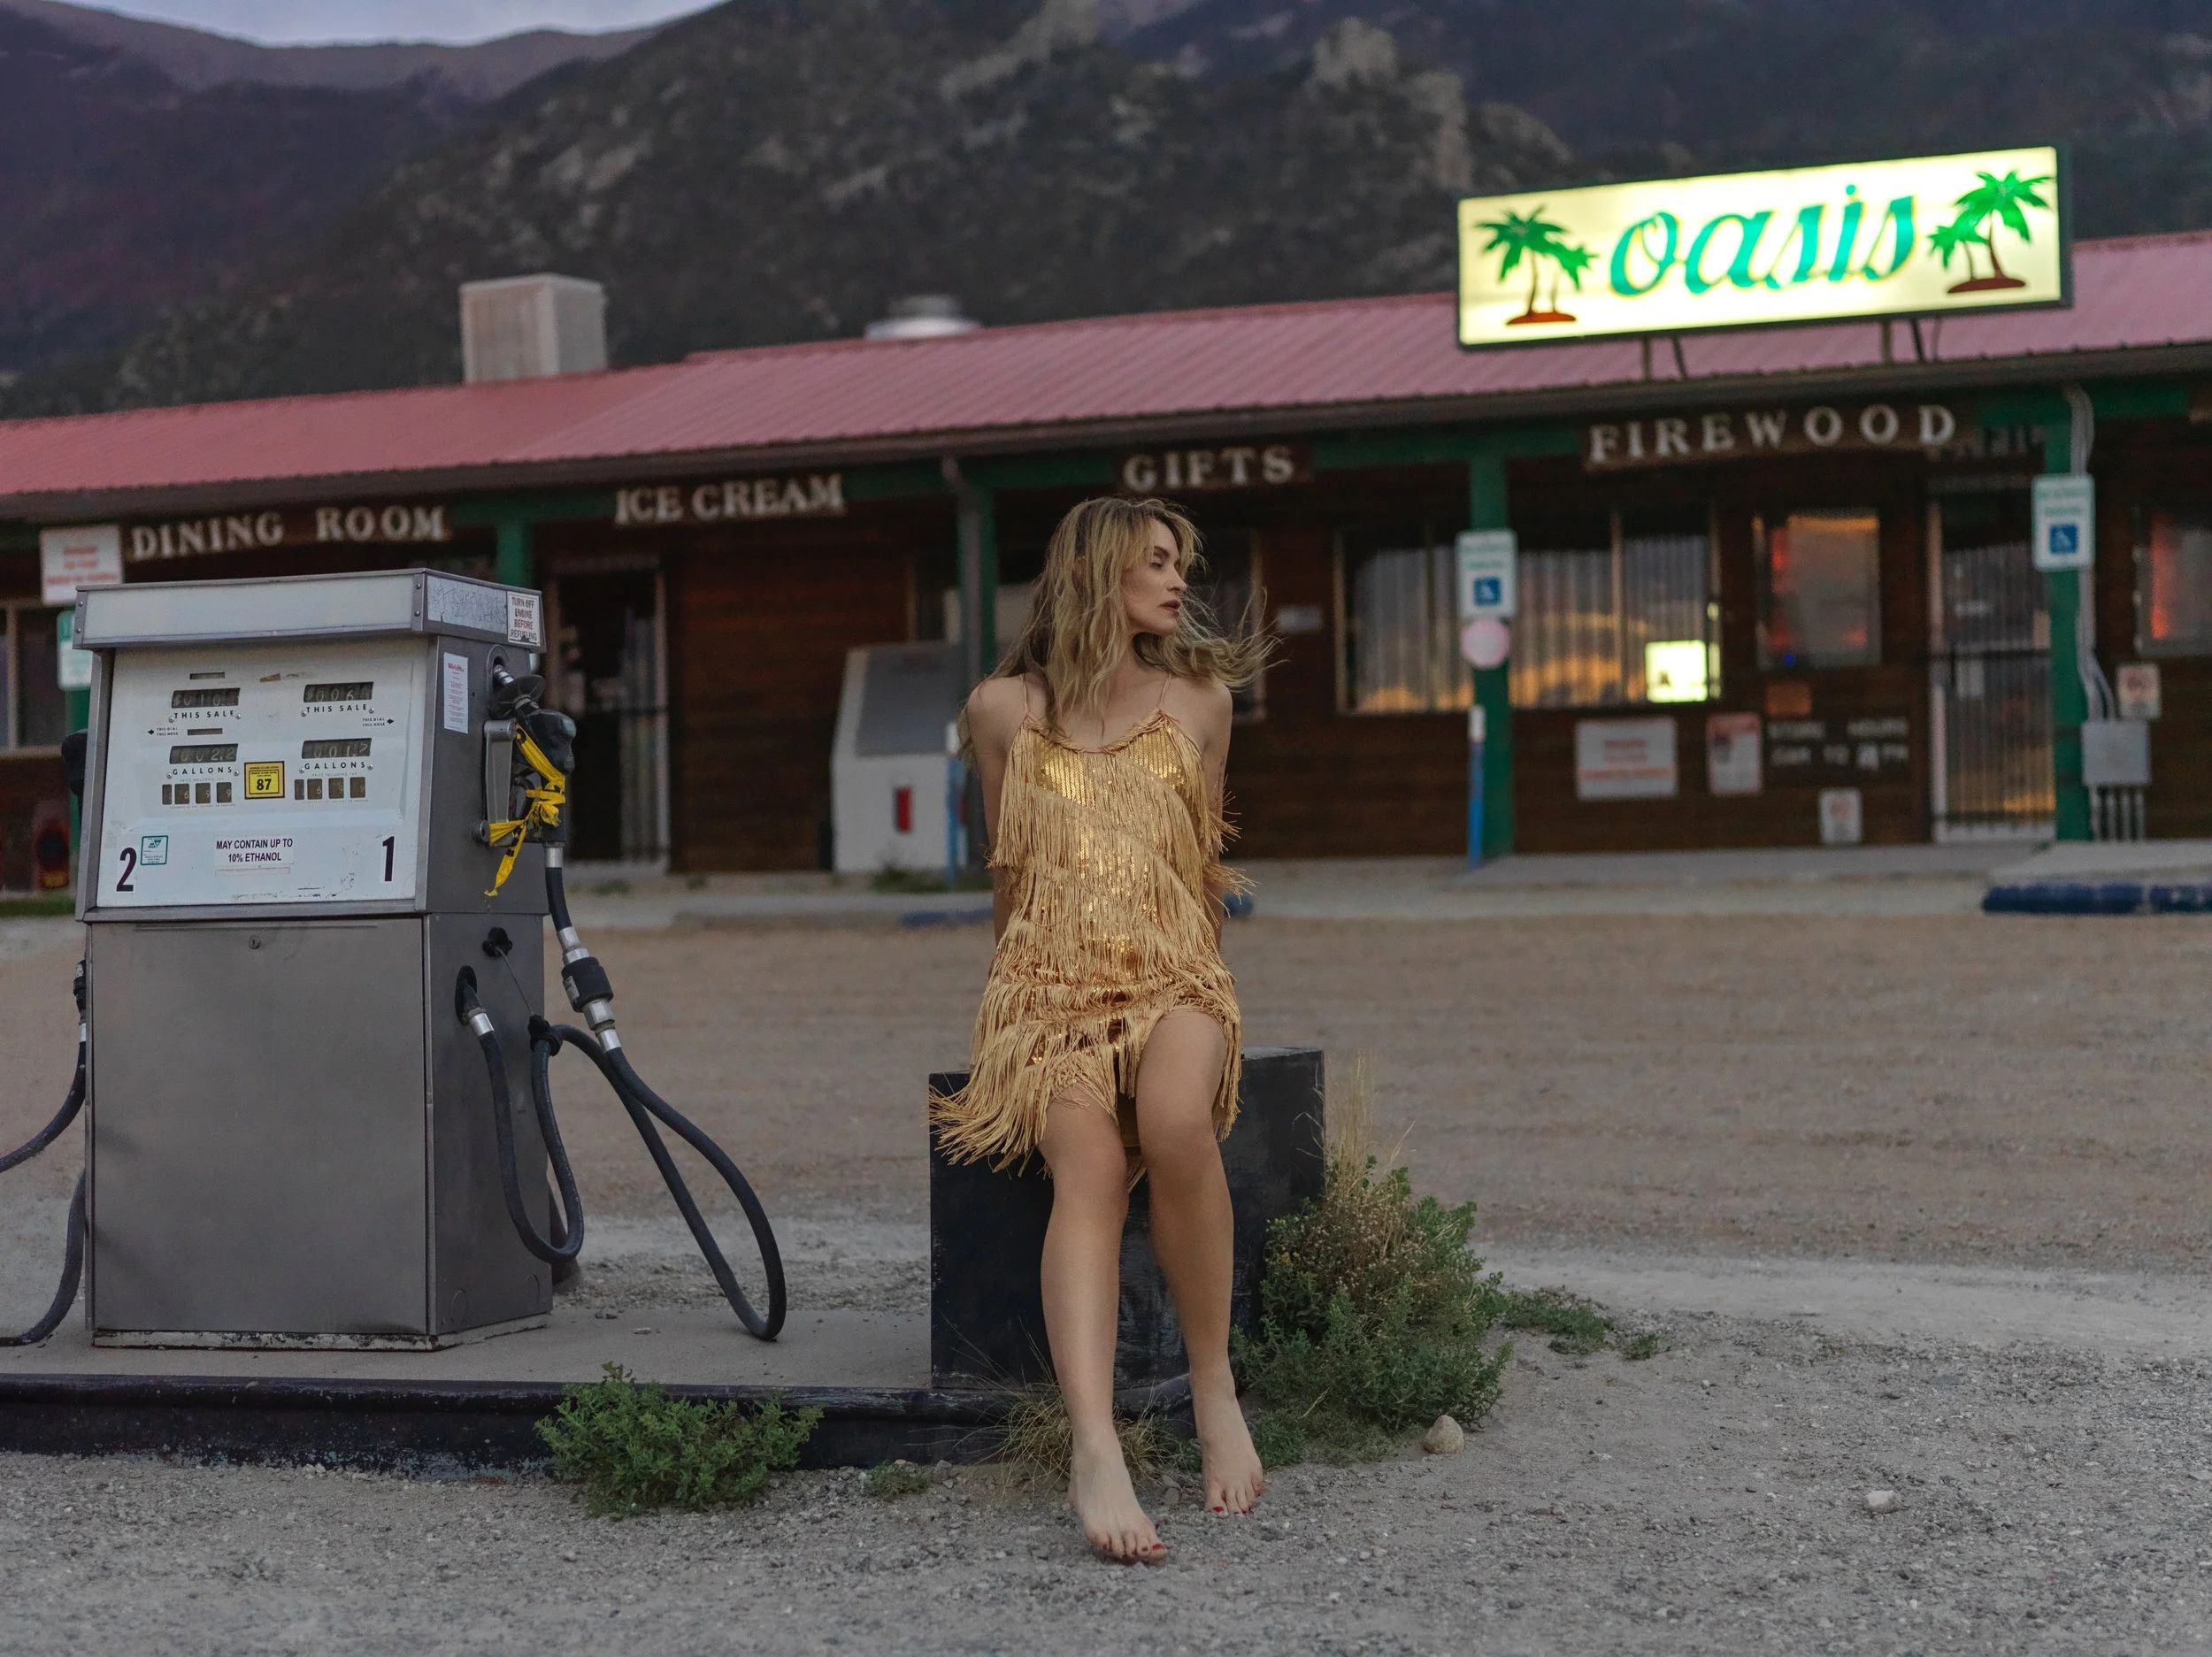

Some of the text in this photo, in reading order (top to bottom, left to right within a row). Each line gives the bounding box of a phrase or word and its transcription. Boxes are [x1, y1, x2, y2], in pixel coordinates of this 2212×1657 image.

[1610, 184, 1916, 296] oasis
[1590, 403, 1955, 464] FIREWOOD
[1123, 444, 1295, 491] GIFTS
[615, 473, 845, 525] ICE CREAM
[130, 505, 449, 561] DINING ROOM
[511, 596, 535, 609] TURN OFF
[514, 608, 533, 619] ENGINE
[514, 618, 533, 630] BEFORE
[173, 766, 233, 775] GALLONS
[257, 779, 272, 790] 87
[216, 838, 293, 849] MAY CONTAIN UP TO
[228, 852, 281, 863] 10% ETHANOL
[116, 847, 137, 892] 2
[382, 836, 395, 882] 1
